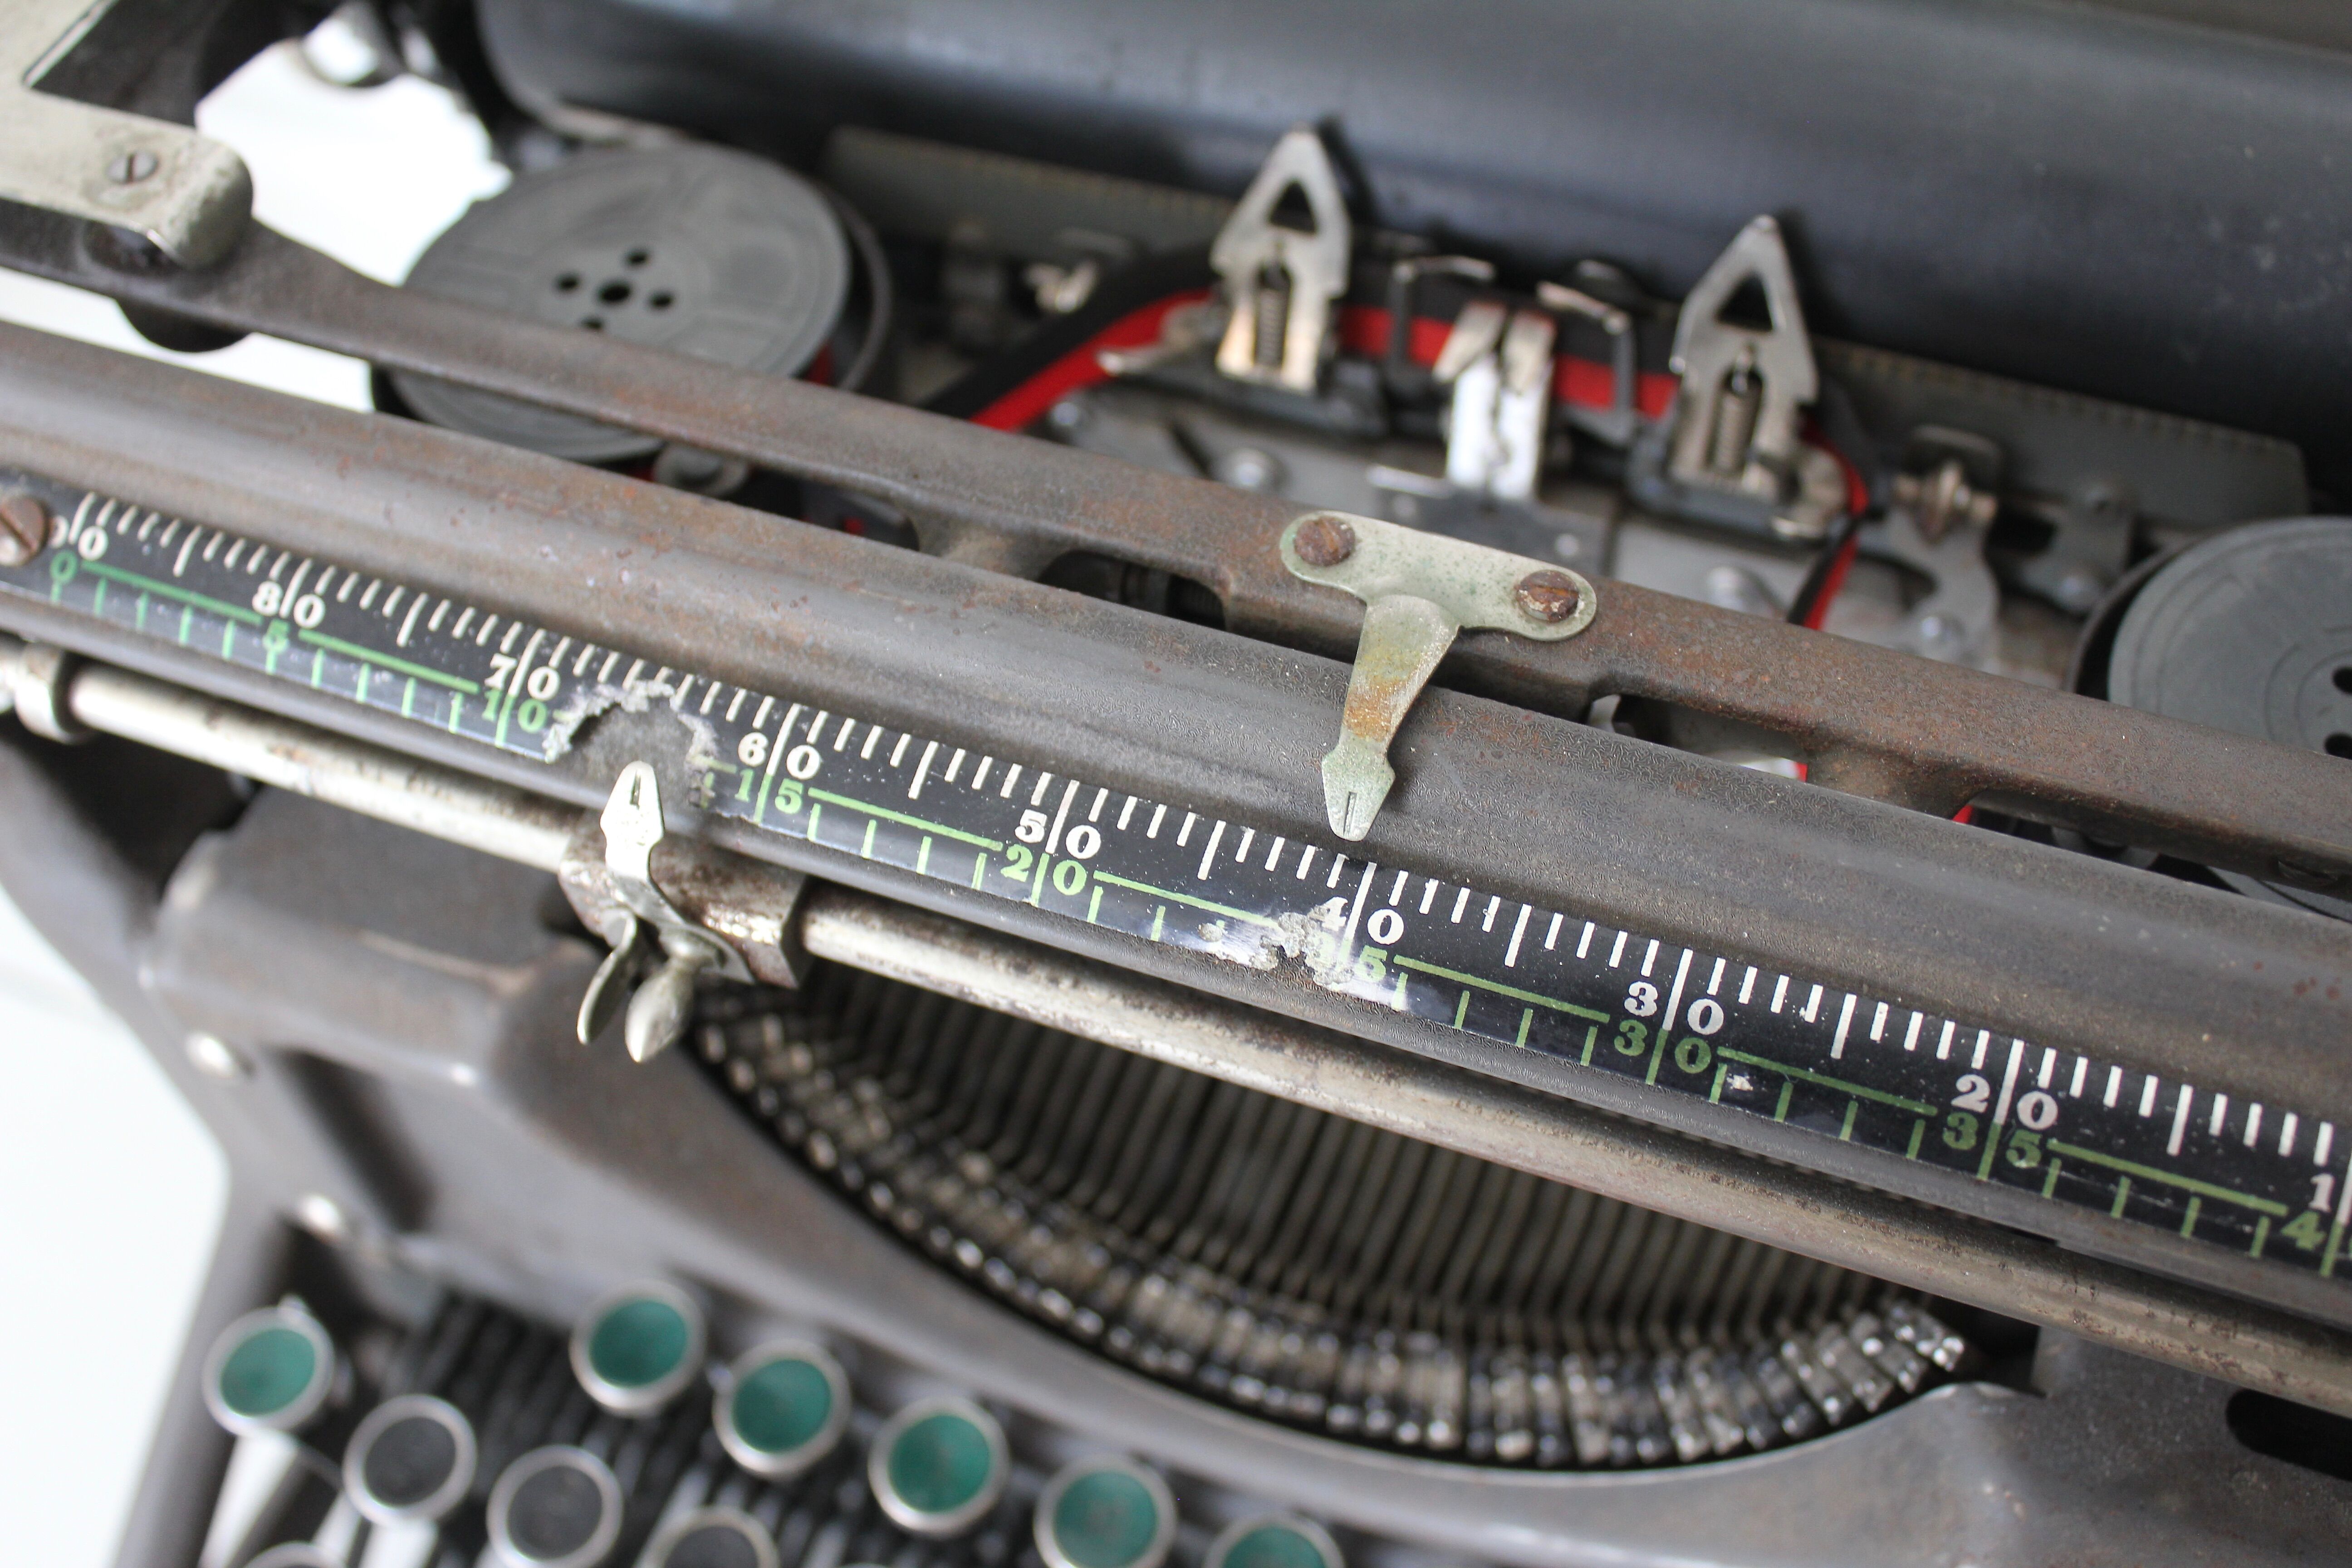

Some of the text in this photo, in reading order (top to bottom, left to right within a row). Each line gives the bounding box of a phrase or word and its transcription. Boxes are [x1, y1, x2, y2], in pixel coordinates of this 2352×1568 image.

[50, 550, 77, 584] 0
[263, 619, 290, 653] 5
[481, 688, 547, 733] 10
[735, 770, 804, 813] 15
[1000, 845, 1087, 895] 20
[1614, 1020, 1711, 1073] 30
[1942, 1112, 2042, 1168] 35
[252, 581, 326, 628] 80
[485, 653, 560, 701] 70
[738, 732, 821, 779] 60
[1015, 809, 1101, 859] 50
[1308, 897, 1404, 945] 40
[1624, 981, 1724, 1035] 30
[1951, 1074, 2058, 1130] 20
